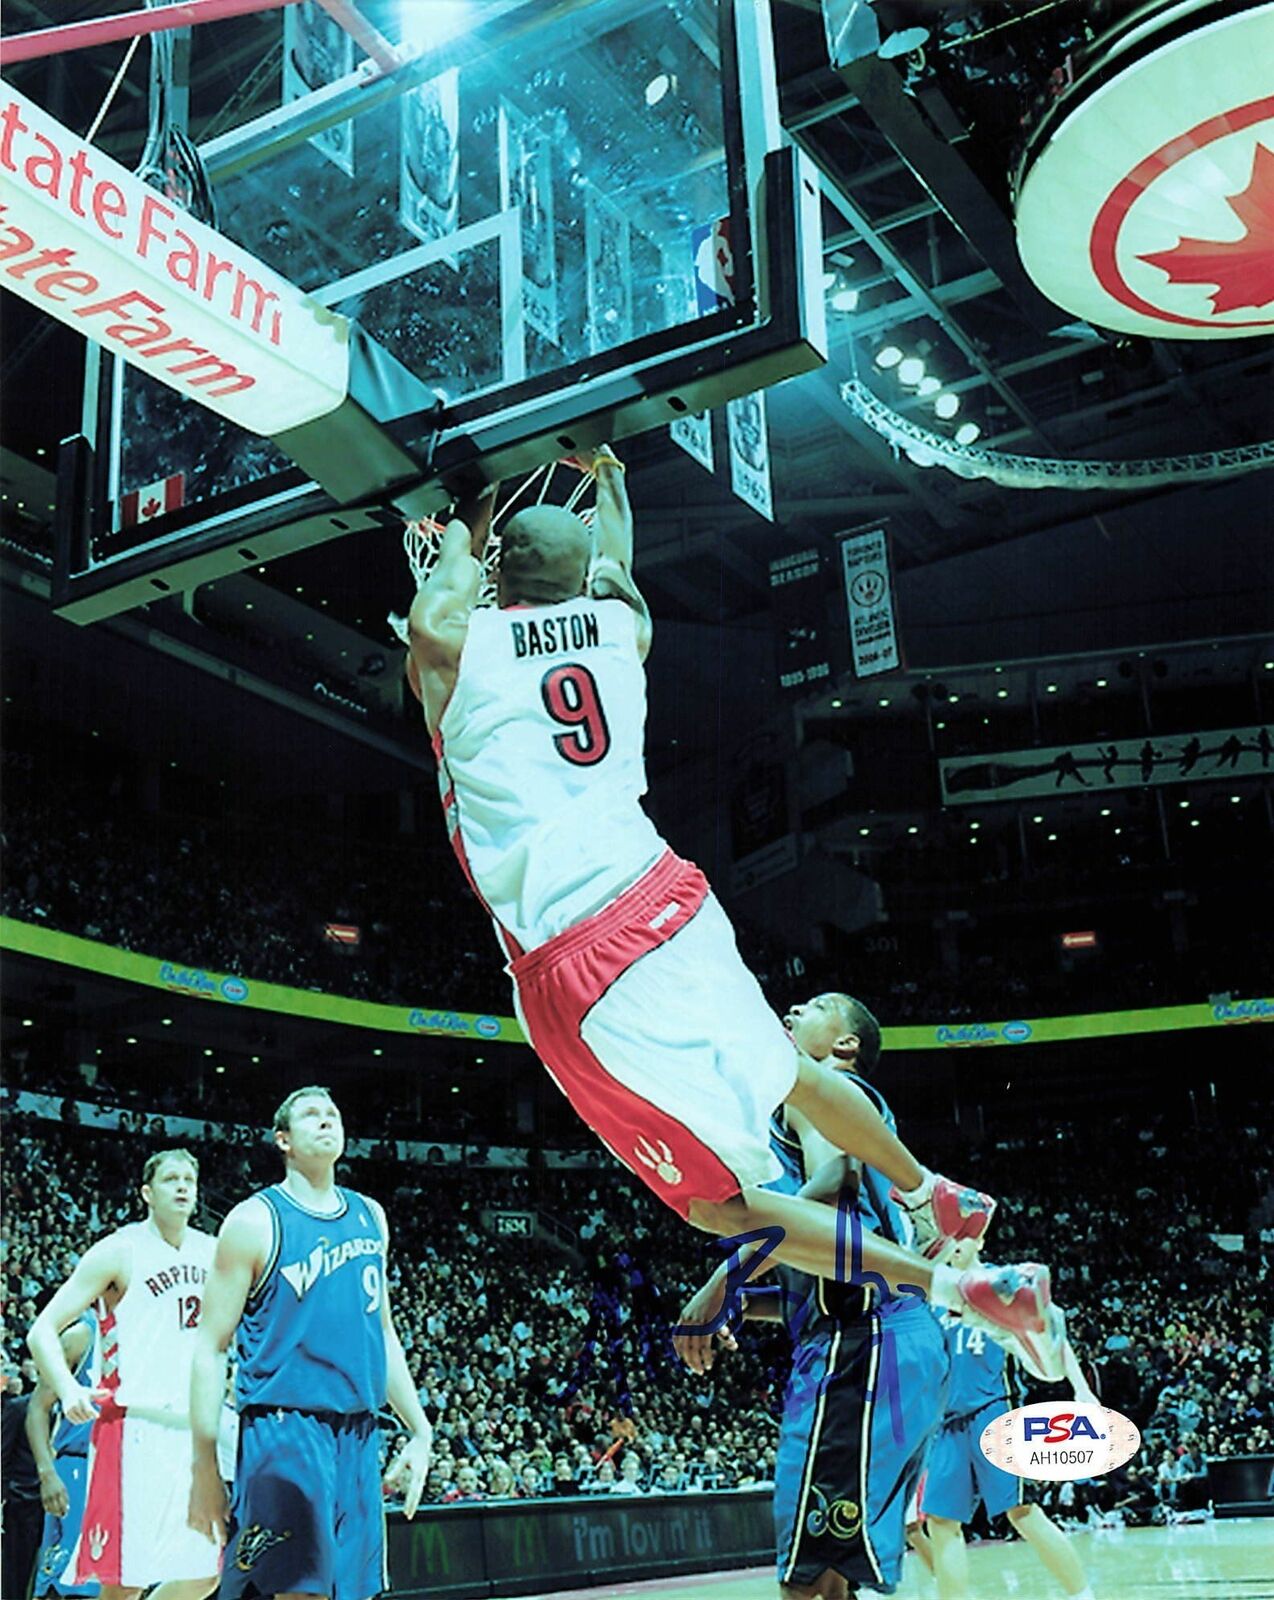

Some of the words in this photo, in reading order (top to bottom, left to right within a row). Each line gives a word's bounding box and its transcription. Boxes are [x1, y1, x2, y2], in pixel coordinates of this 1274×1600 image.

[511, 612, 599, 658] BASTON
[541, 662, 611, 768] 9
[363, 1265, 381, 1314] 9
[178, 1295, 202, 1331] 12
[956, 1327, 986, 1355] 14
